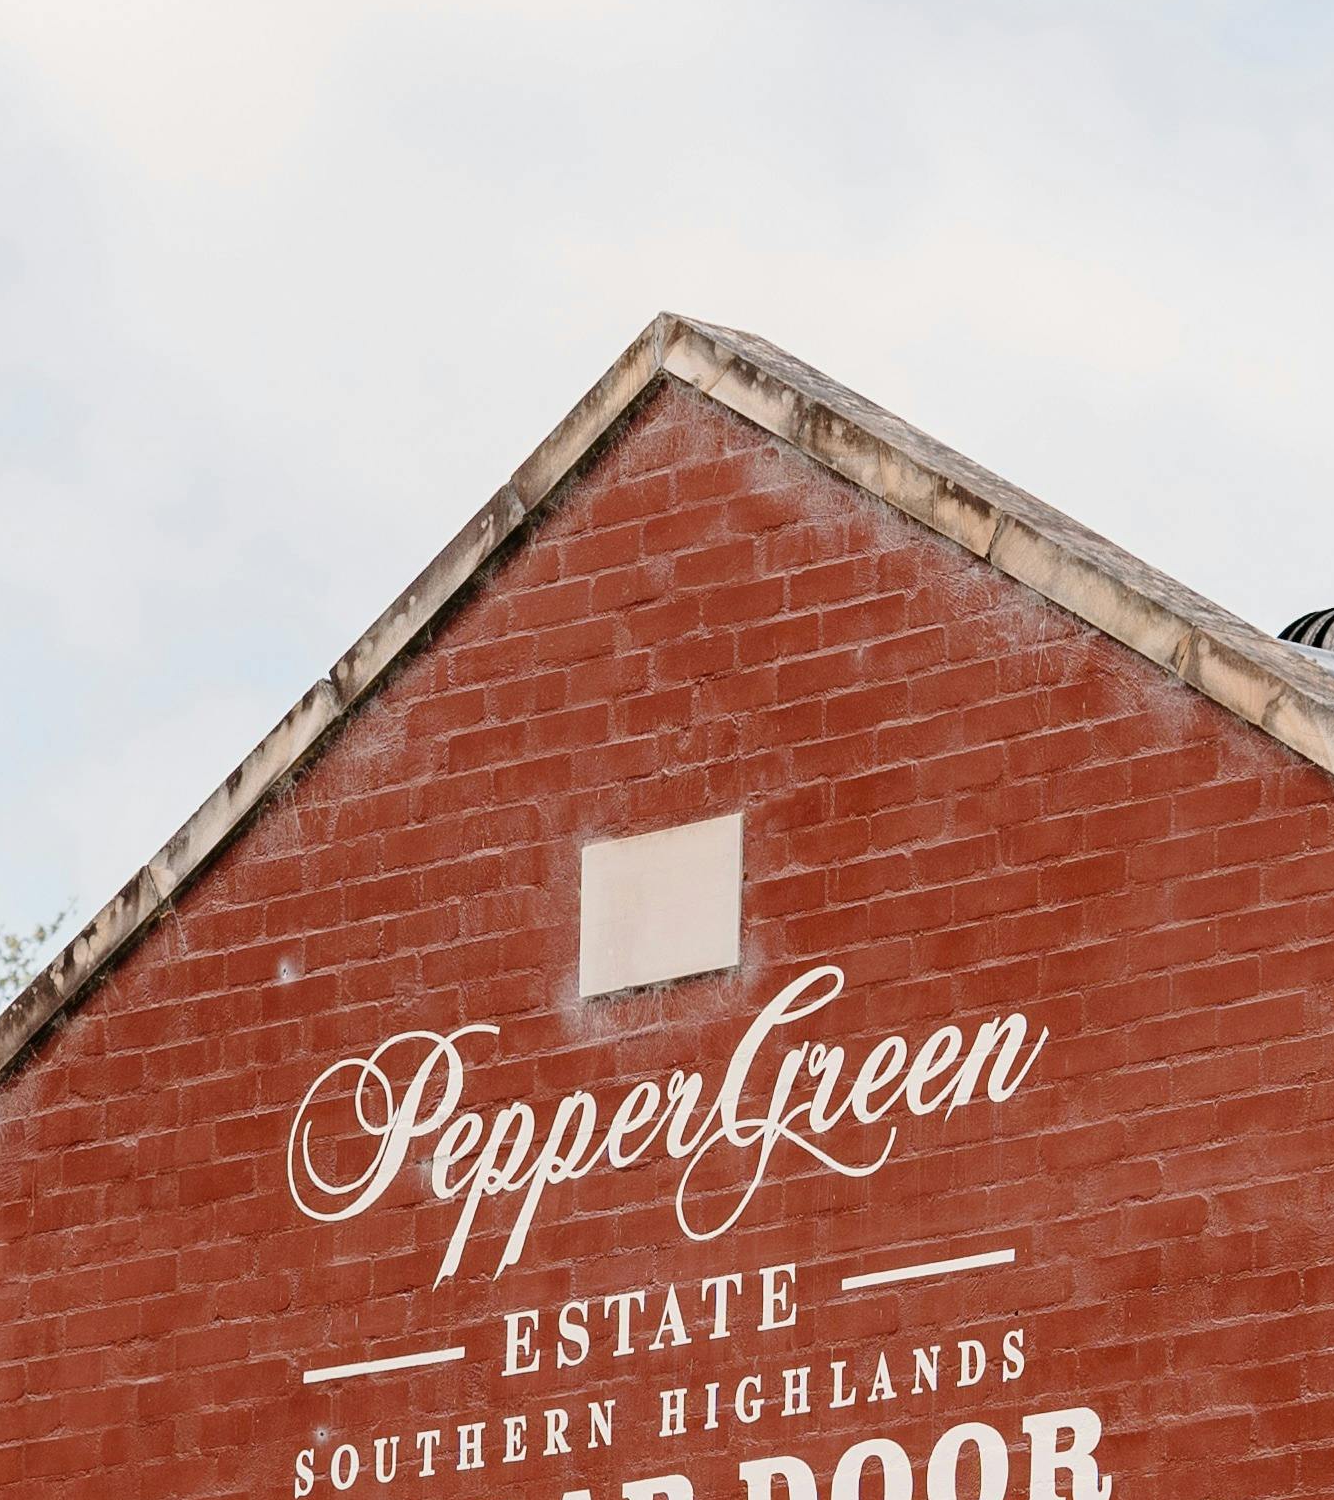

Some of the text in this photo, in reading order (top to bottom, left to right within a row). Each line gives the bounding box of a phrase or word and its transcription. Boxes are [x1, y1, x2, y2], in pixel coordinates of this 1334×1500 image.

[287, 965, 1049, 1289] PepperGreen
[501, 1263, 798, 1376] ESTATE
[294, 1328, 1027, 1498] SOUTHERN HIGHLANDS
